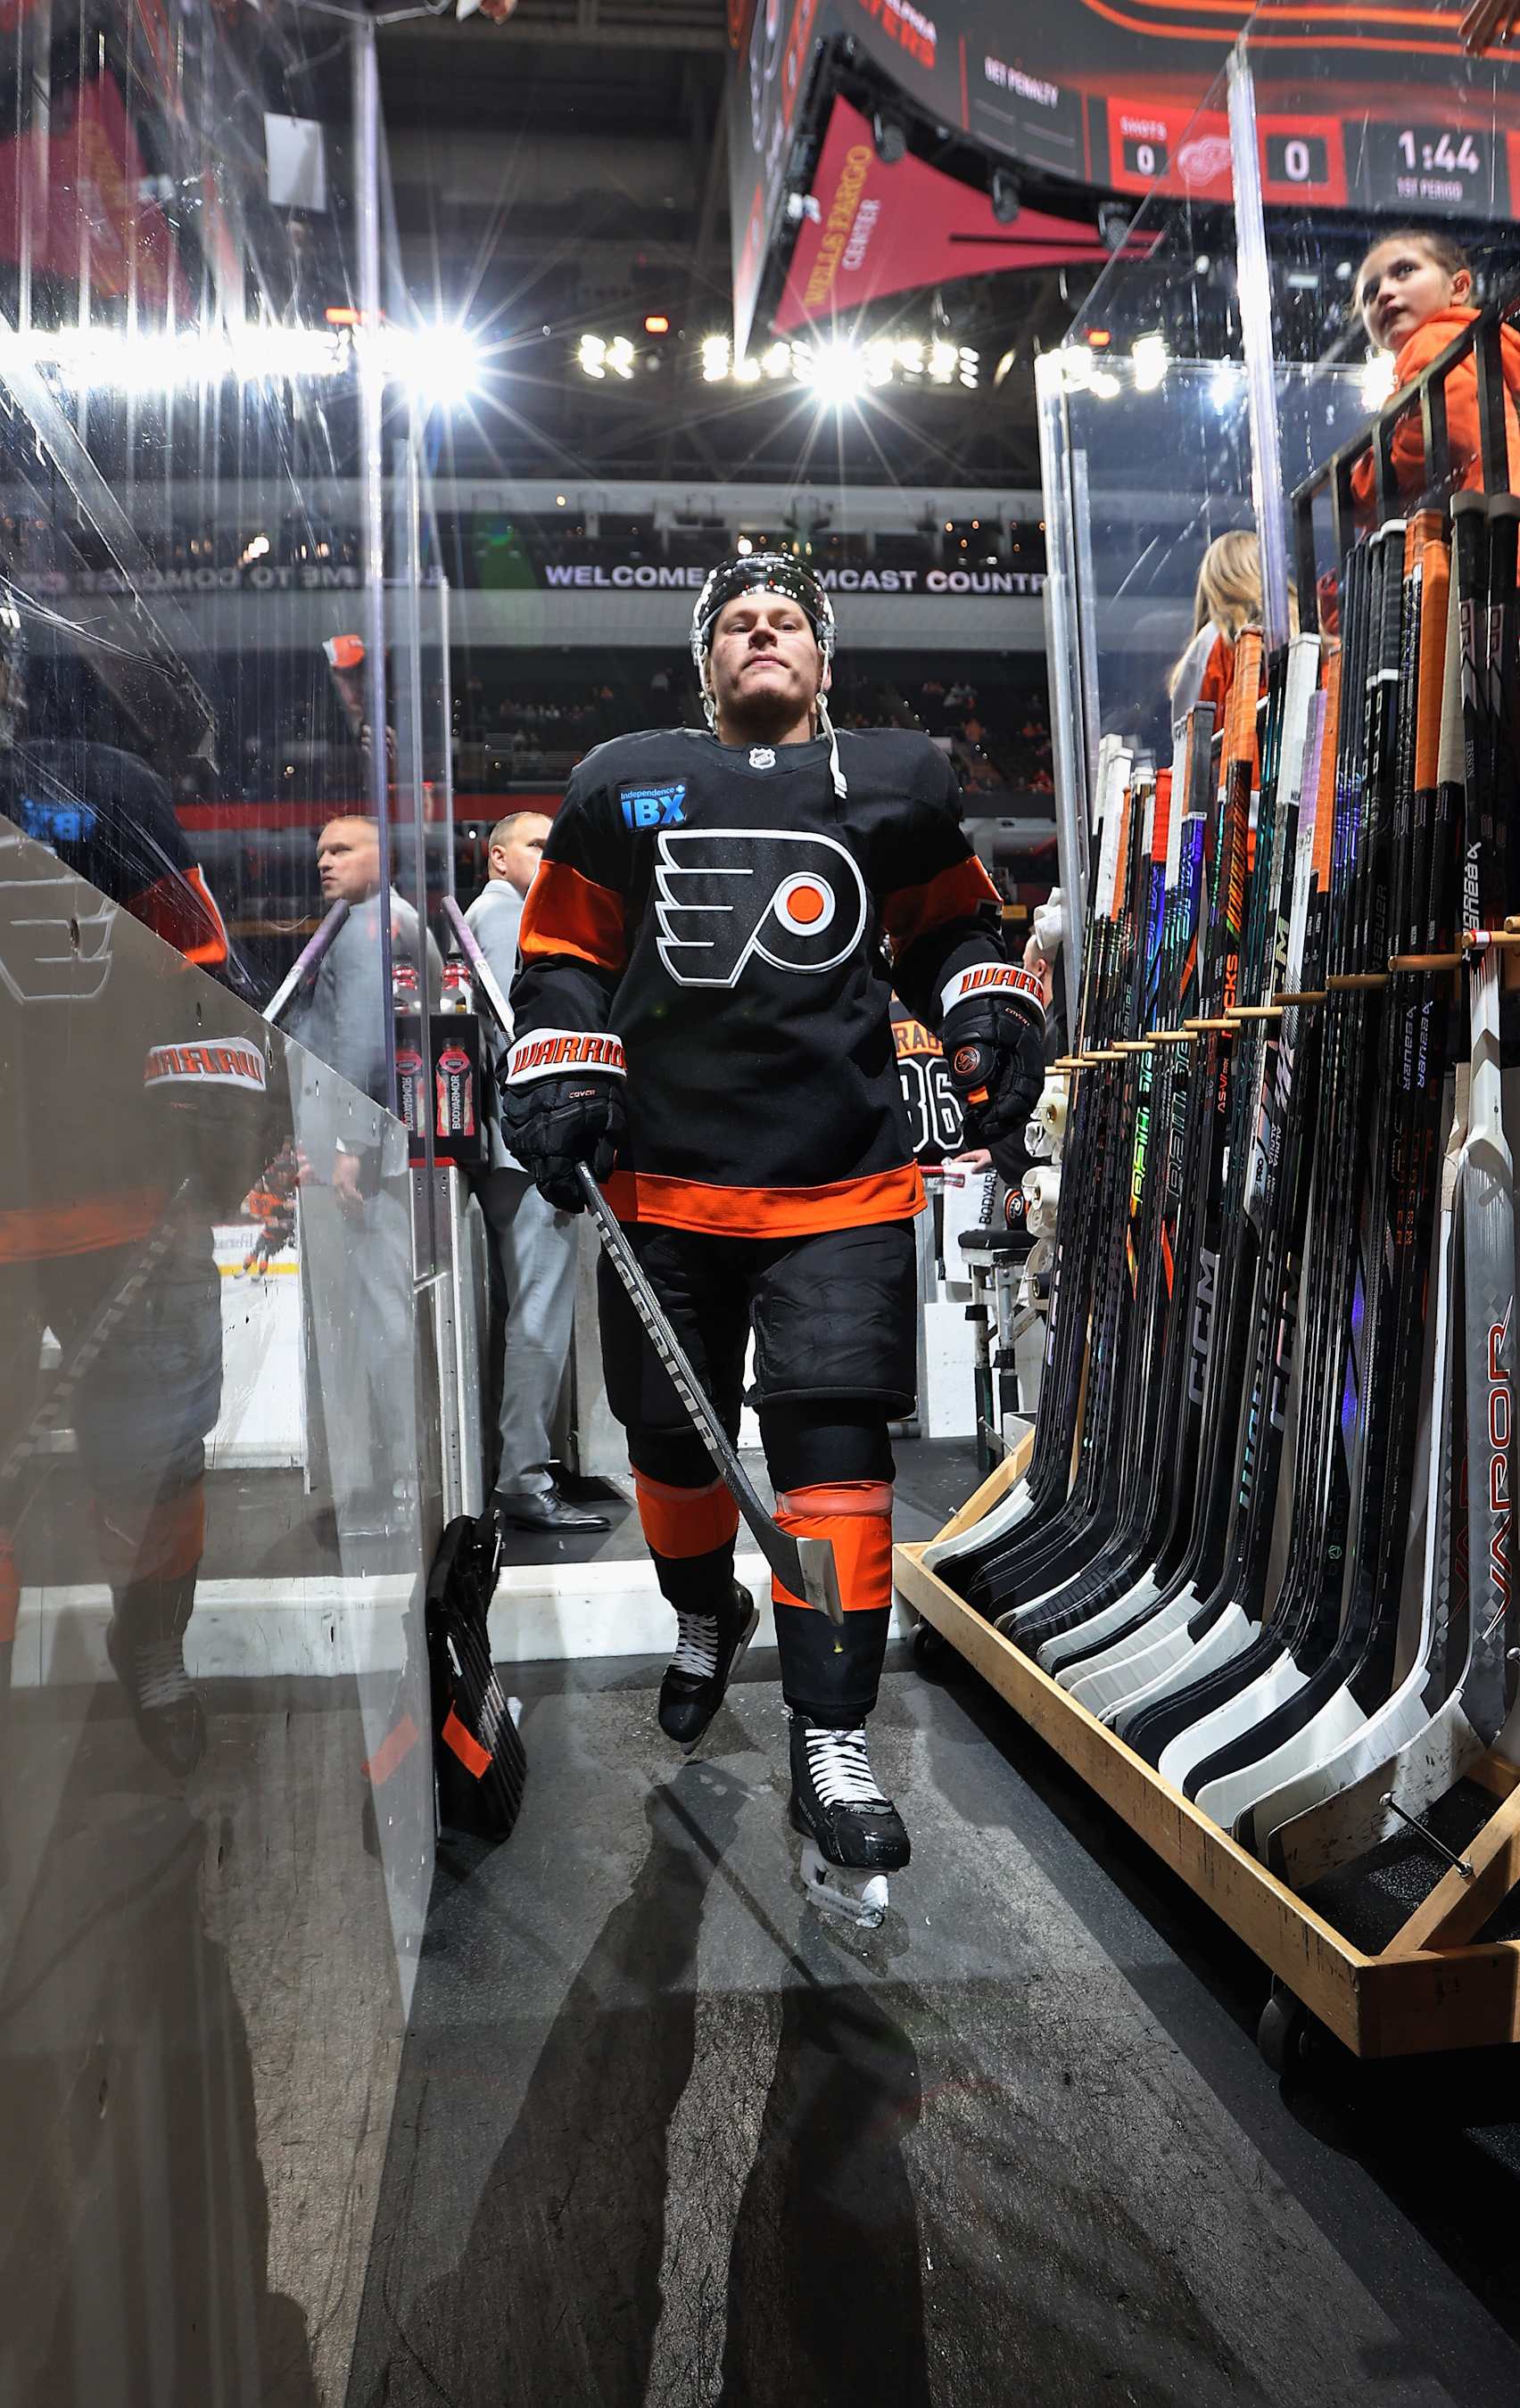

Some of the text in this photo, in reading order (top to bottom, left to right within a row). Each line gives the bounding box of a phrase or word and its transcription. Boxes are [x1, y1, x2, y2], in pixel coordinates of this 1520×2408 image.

[1120, 117, 1168, 140] SHOTS
[1136, 140, 1309, 181] 0 0
[1397, 130, 1481, 174] 1:44
[1419, 179, 1463, 202] PERIOD
[804, 145, 874, 307] WELLS FARGO
[841, 199, 881, 271] CENTER
[545, 565, 704, 589] WELCOME
[814, 569, 916, 591] MCAST
[621, 786, 675, 801] Independence
[621, 793, 685, 829] IBX
[1402, 1020, 1414, 1091] BAUER
[1417, 1016, 1429, 1089] BAUER
[450, 1075, 461, 1130] BODYARMOR
[1255, 1158, 1264, 1183] PRO
[1188, 1248, 1218, 1406] CCM
[1482, 1298, 1514, 1640] VAPOR
